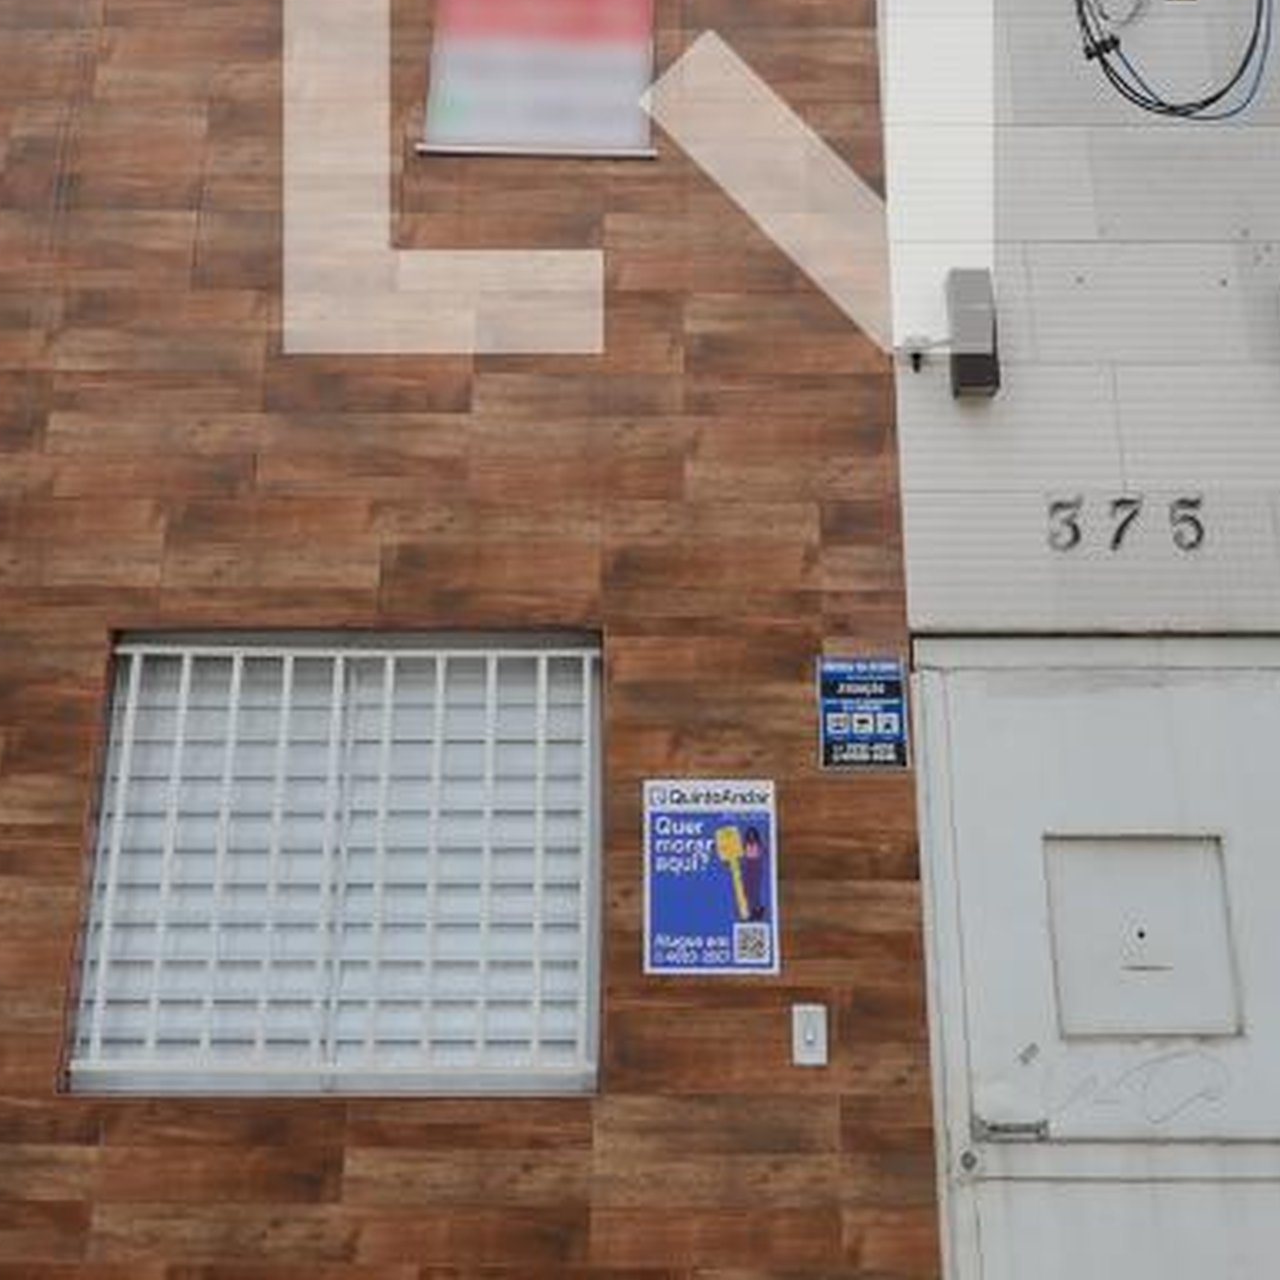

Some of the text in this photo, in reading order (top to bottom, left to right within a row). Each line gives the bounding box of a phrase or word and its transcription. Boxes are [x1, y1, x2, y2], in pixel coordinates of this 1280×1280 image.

[1048, 495, 1205, 553] 375
[656, 816, 704, 835] Quer
[656, 839, 714, 854] morar
